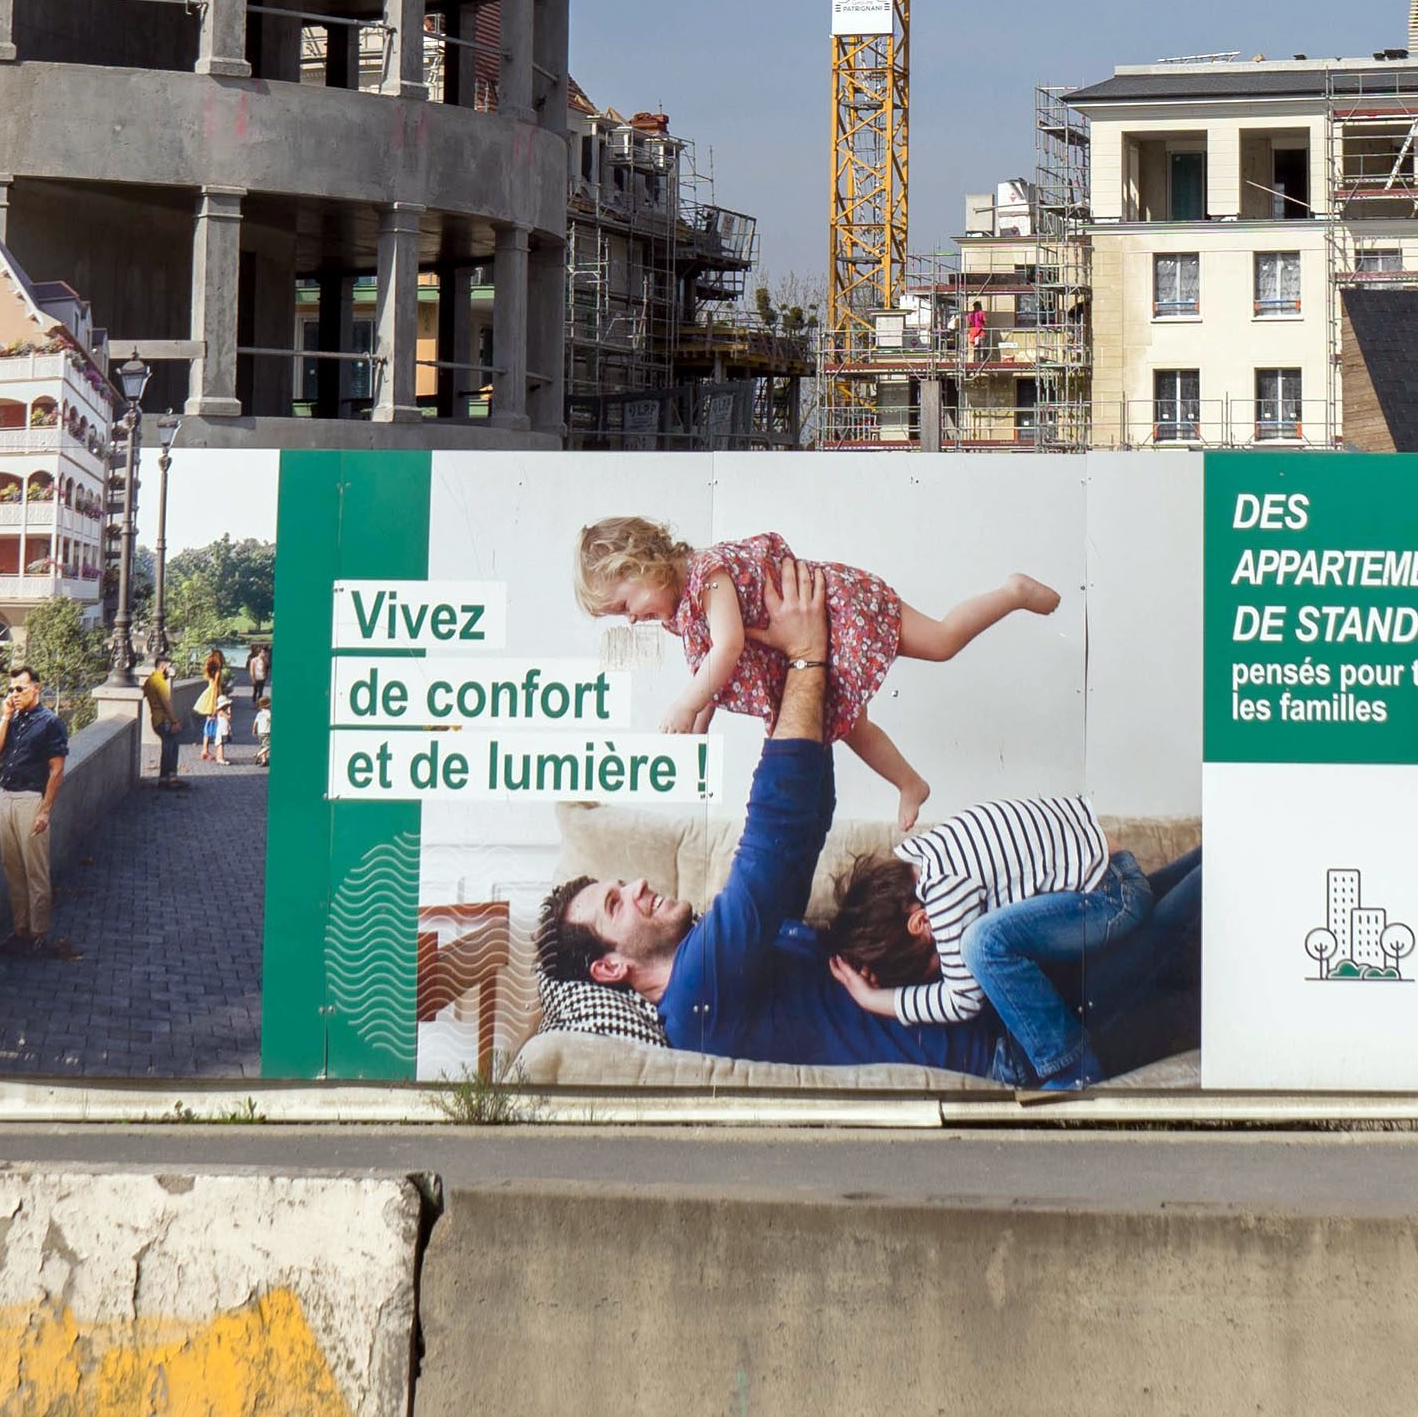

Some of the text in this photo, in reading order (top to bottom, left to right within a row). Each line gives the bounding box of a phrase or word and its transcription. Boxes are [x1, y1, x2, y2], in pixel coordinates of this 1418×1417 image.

[1233, 494, 1309, 529] DES
[352, 590, 486, 641] Vivez
[1233, 606, 1286, 642] DE
[1232, 657, 1330, 690] pensés
[1340, 663, 1404, 690] pour
[349, 667, 609, 719] de confort
[1232, 691, 1388, 723] les familles
[347, 740, 707, 792] et de lumière !
